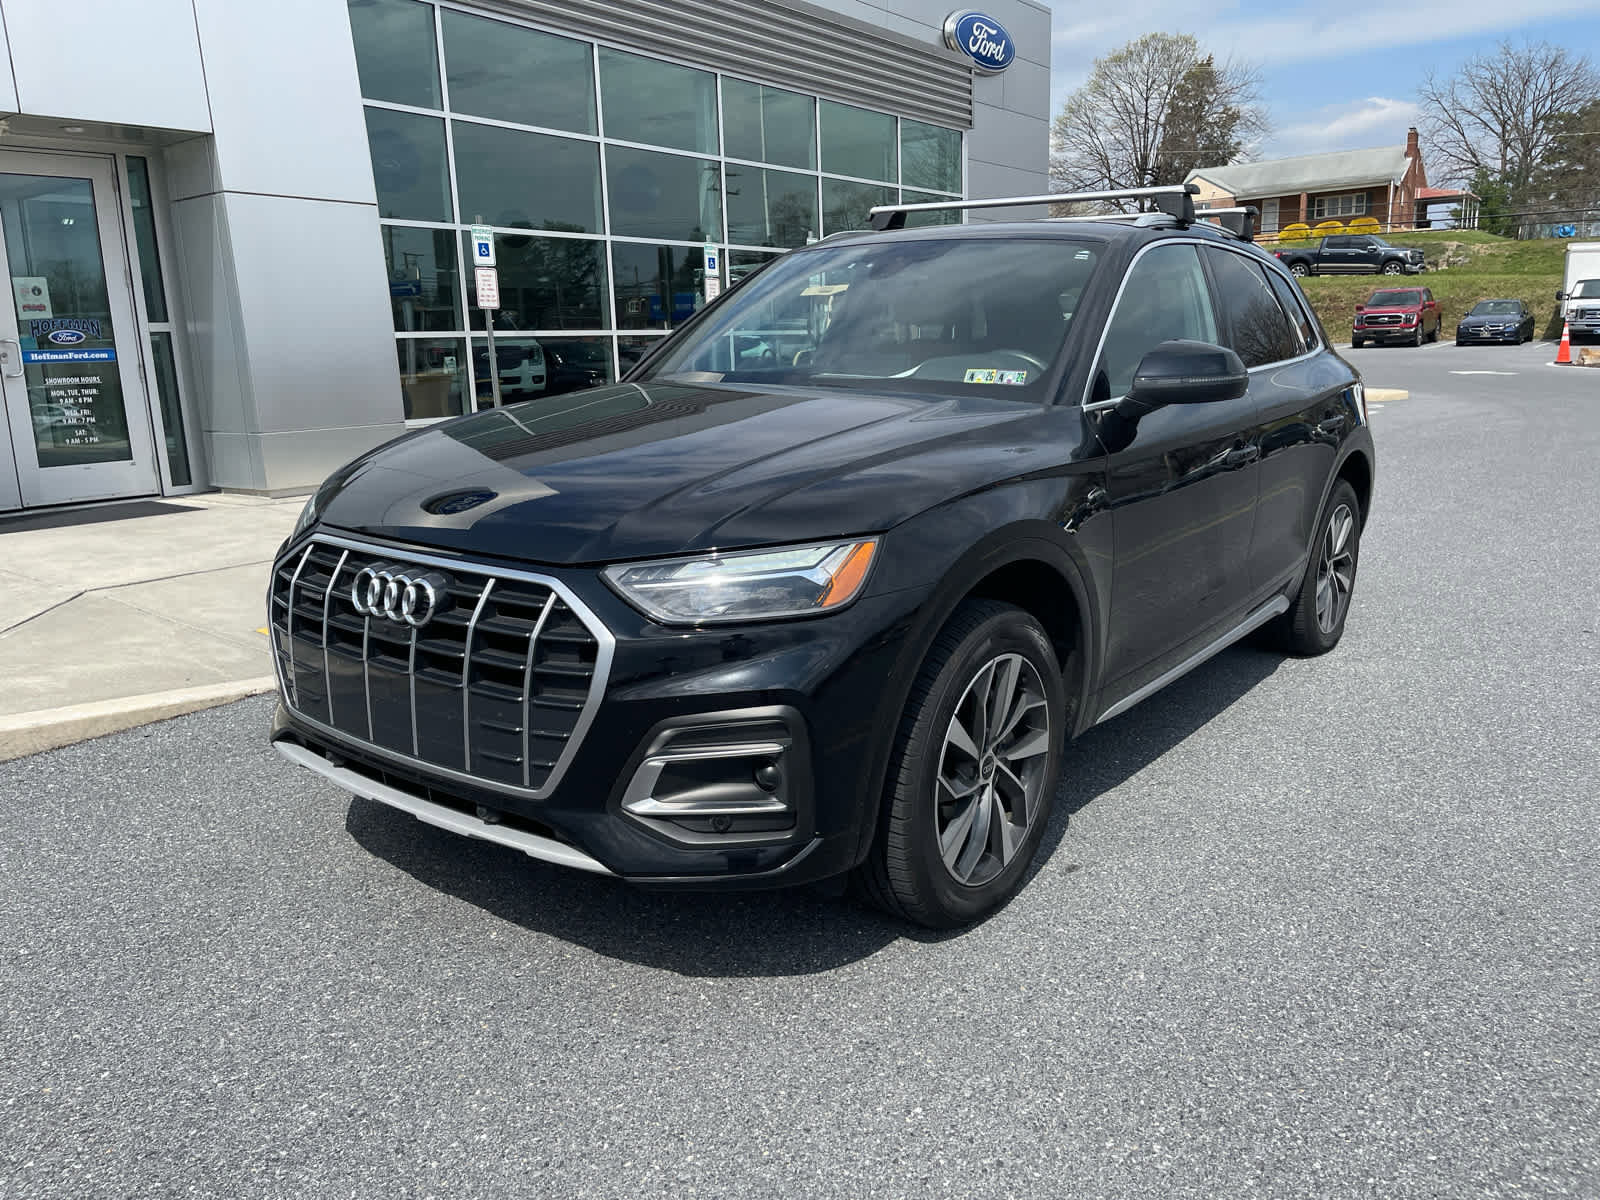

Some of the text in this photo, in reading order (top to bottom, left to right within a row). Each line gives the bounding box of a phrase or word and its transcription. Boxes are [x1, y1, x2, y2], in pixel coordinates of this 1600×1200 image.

[968, 21, 1006, 62] Ford
[30, 318, 102, 340] HOFFMAN
[56, 333, 78, 342] Ford
[30, 352, 109, 361] HoffmanFord.com
[45, 376, 101, 385] SHOWROOM HOURS
